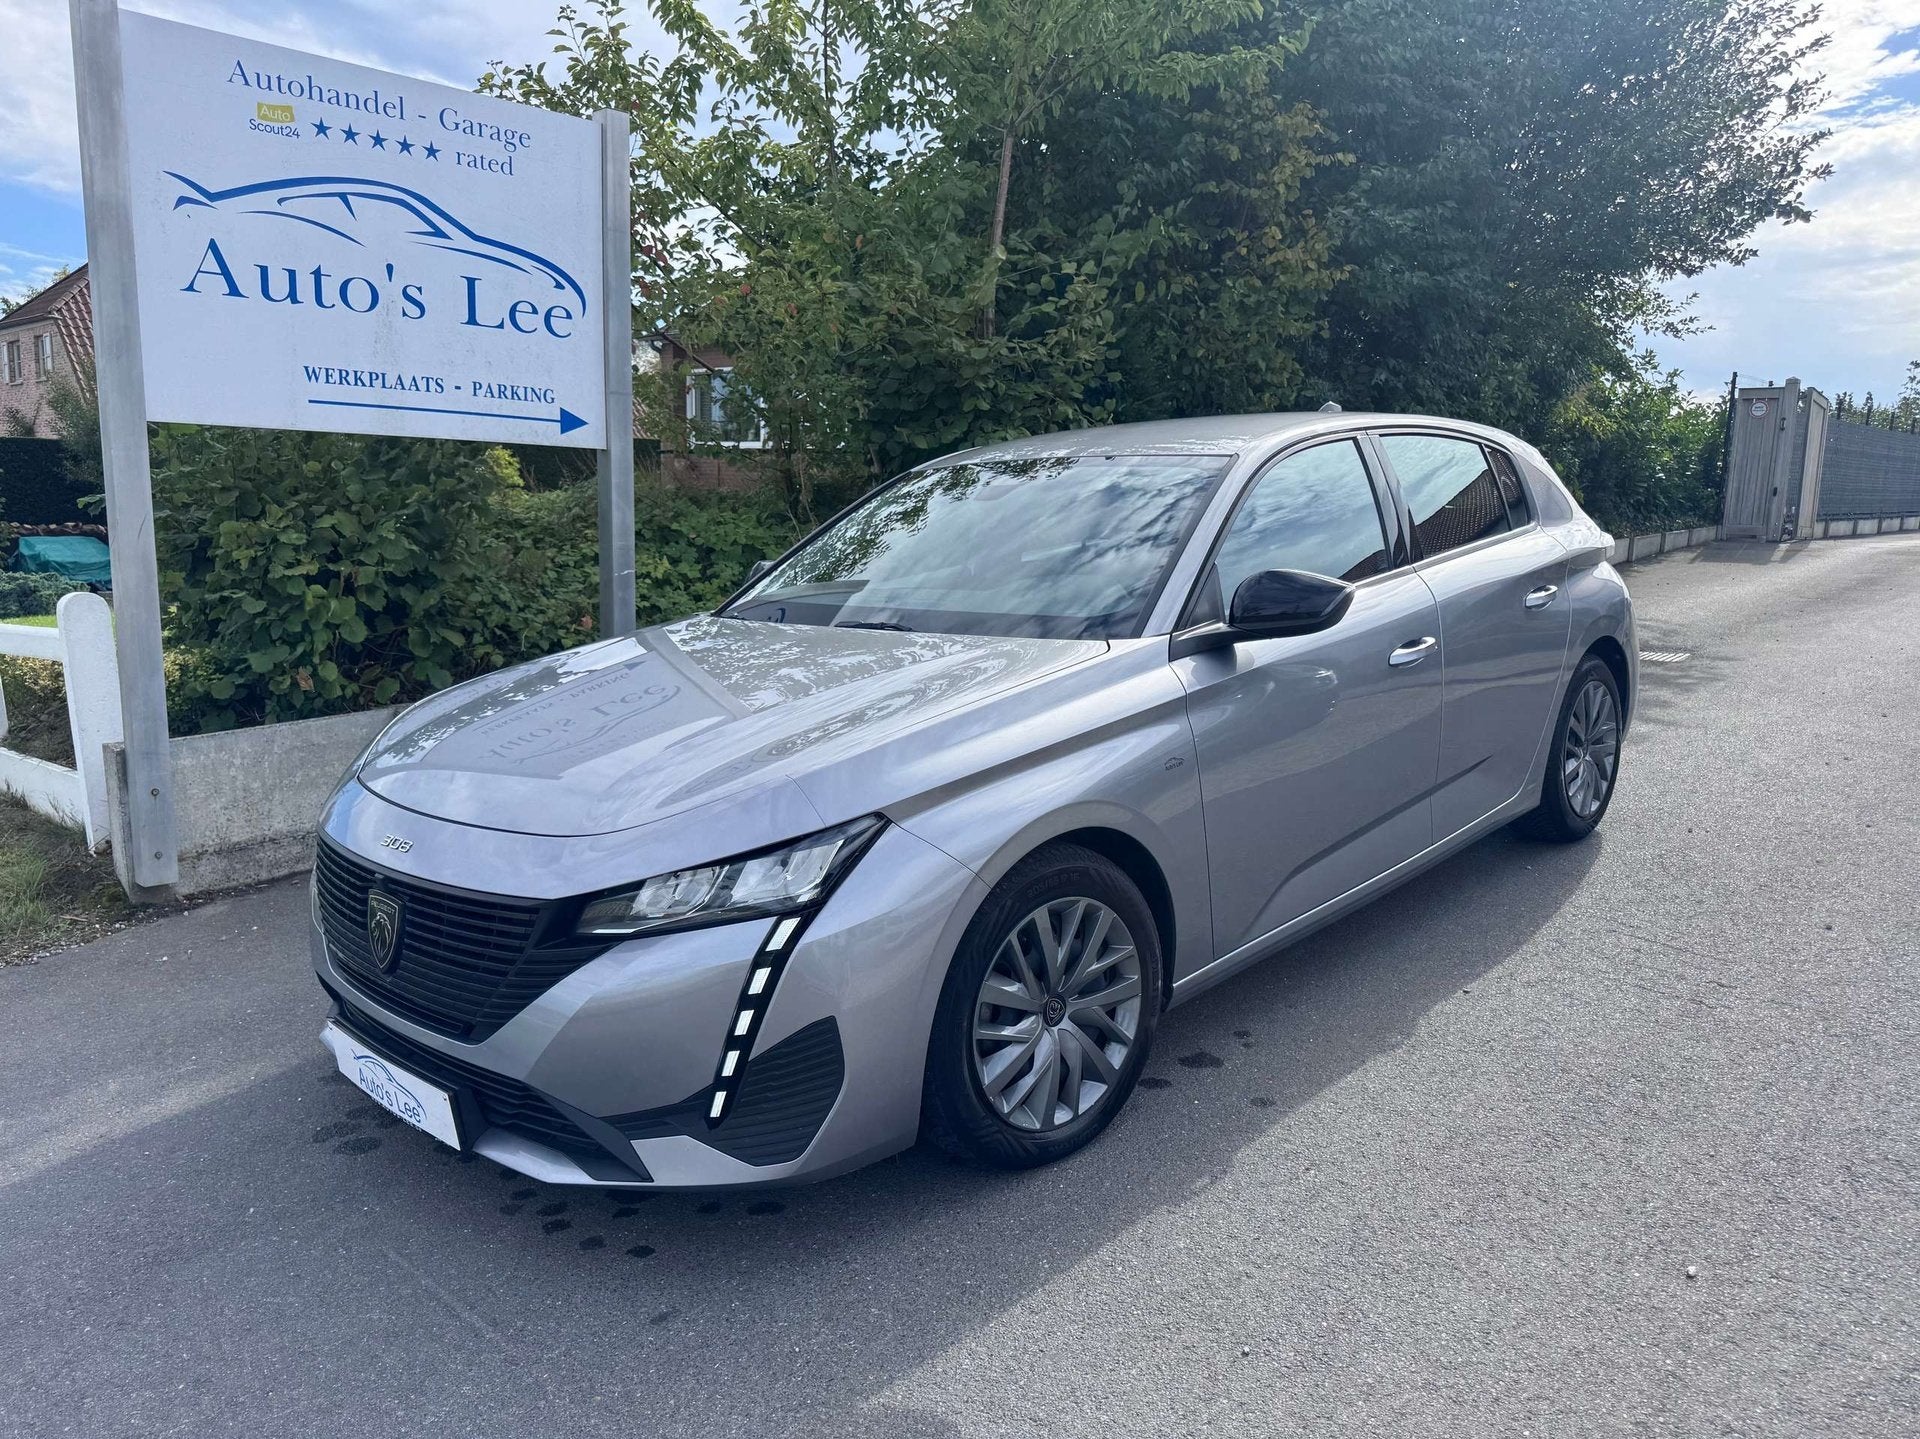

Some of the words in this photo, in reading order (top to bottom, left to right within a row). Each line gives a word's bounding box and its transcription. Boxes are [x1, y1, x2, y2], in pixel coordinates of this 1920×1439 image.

[226, 59, 406, 121] Autohandel
[438, 107, 531, 152] Garage
[260, 104, 291, 122] Auto
[249, 118, 301, 139] Scout24
[455, 151, 514, 176] rated
[179, 237, 427, 320] Auto's
[459, 275, 573, 339] Lee
[302, 365, 445, 394] WERKPLAATS
[471, 380, 556, 405] PARKING
[380, 834, 414, 853] 308
[359, 1067, 393, 1107] Auto's
[394, 1091, 421, 1123] Lee
